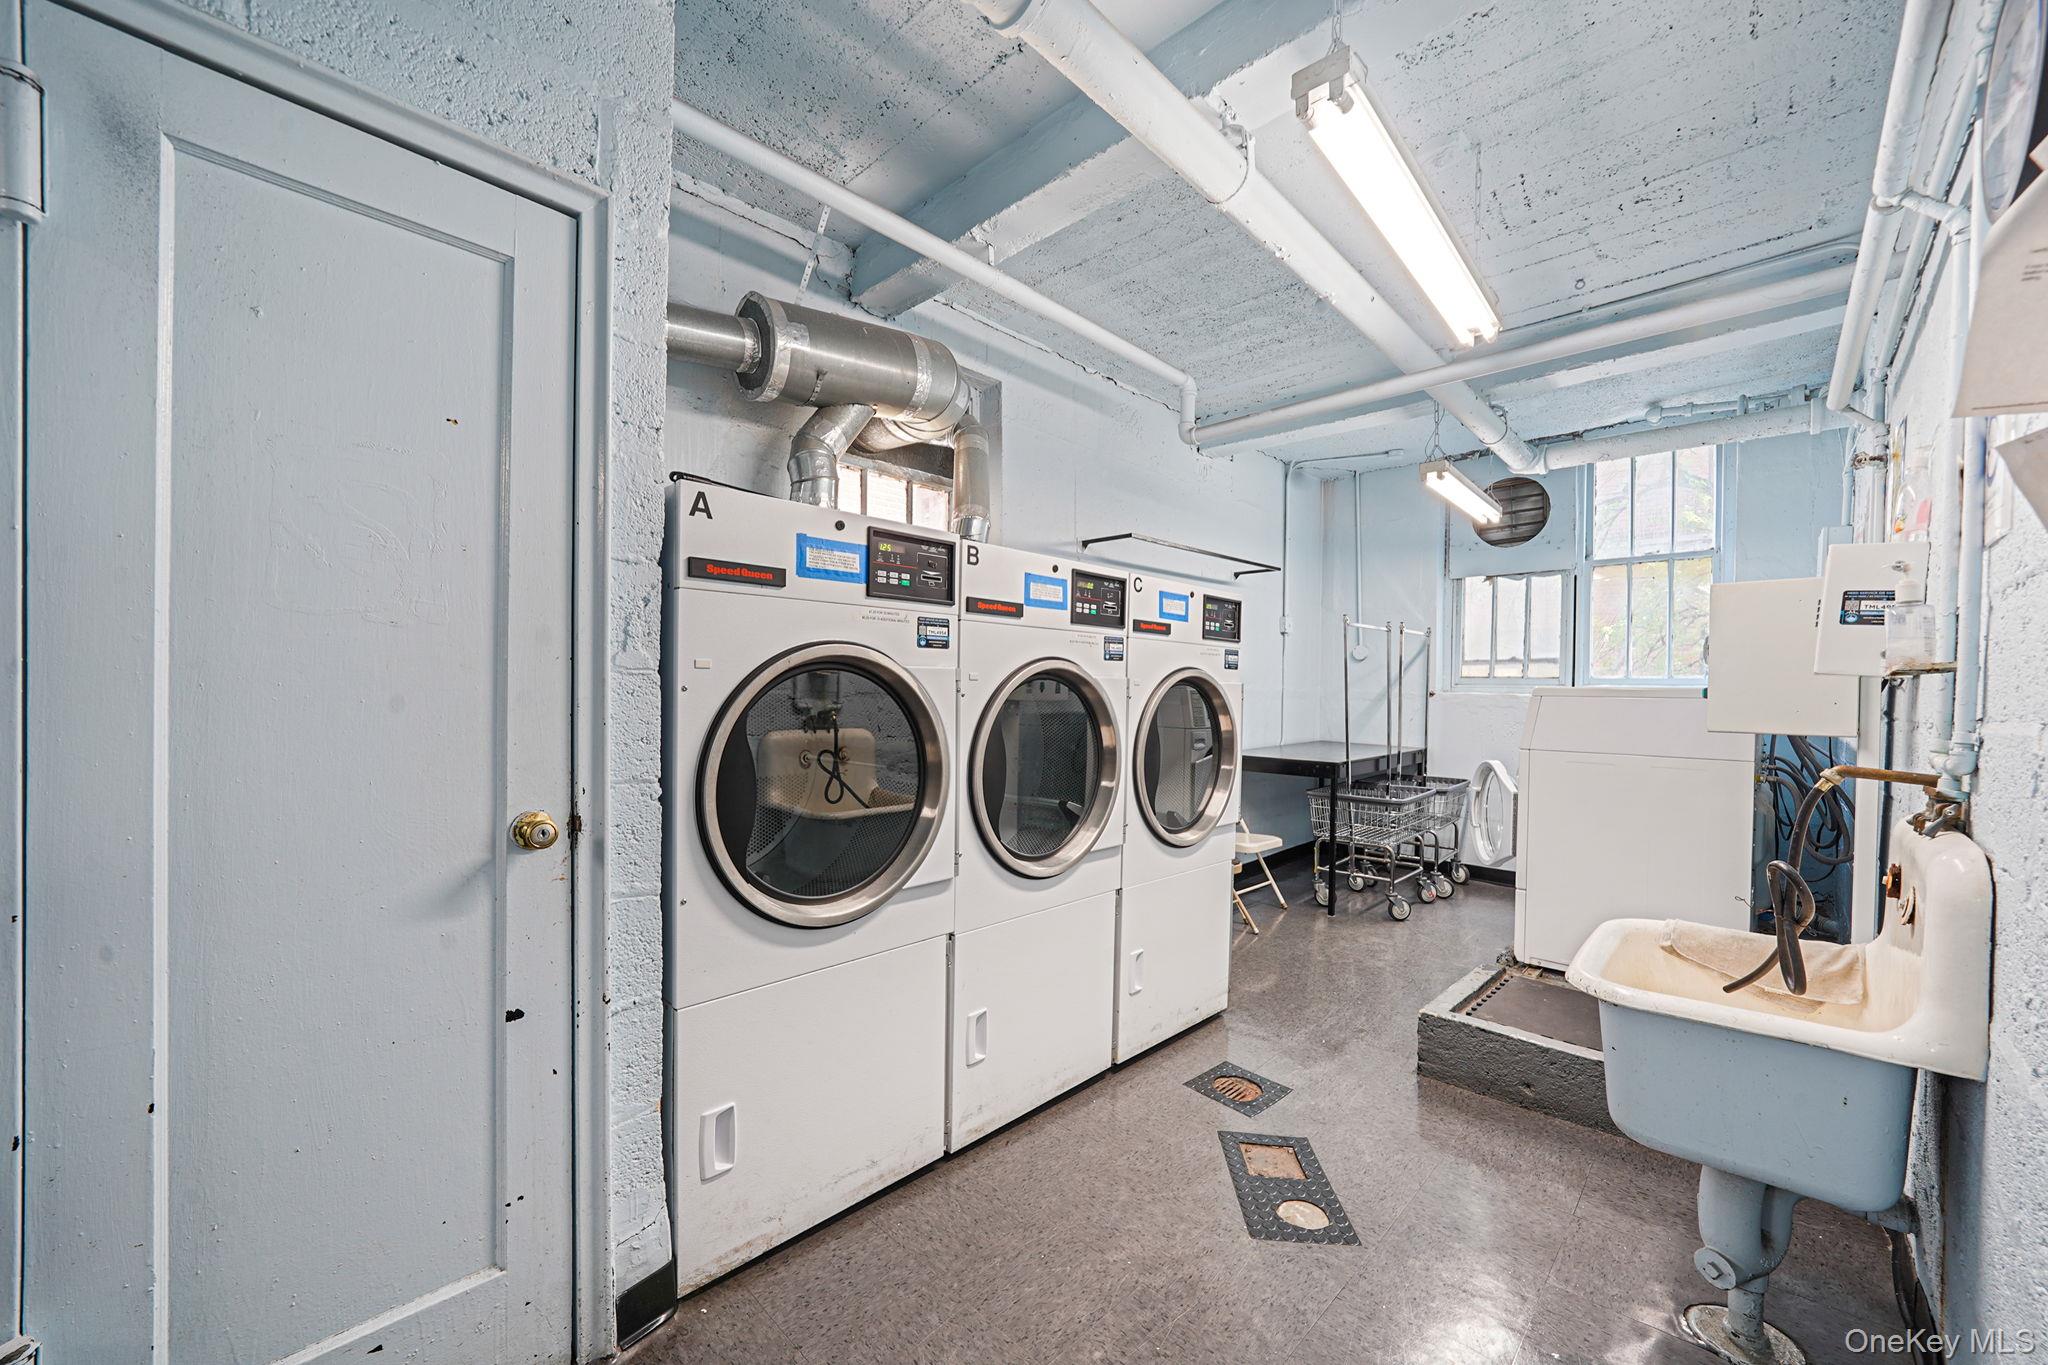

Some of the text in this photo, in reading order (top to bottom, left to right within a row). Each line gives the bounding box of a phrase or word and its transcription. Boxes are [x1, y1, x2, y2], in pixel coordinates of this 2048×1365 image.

[689, 491, 713, 519] A
[967, 545, 979, 565] B
[706, 563, 773, 580] Speed Queen
[1133, 577, 1142, 592] C
[977, 601, 1016, 612] Speed Queen
